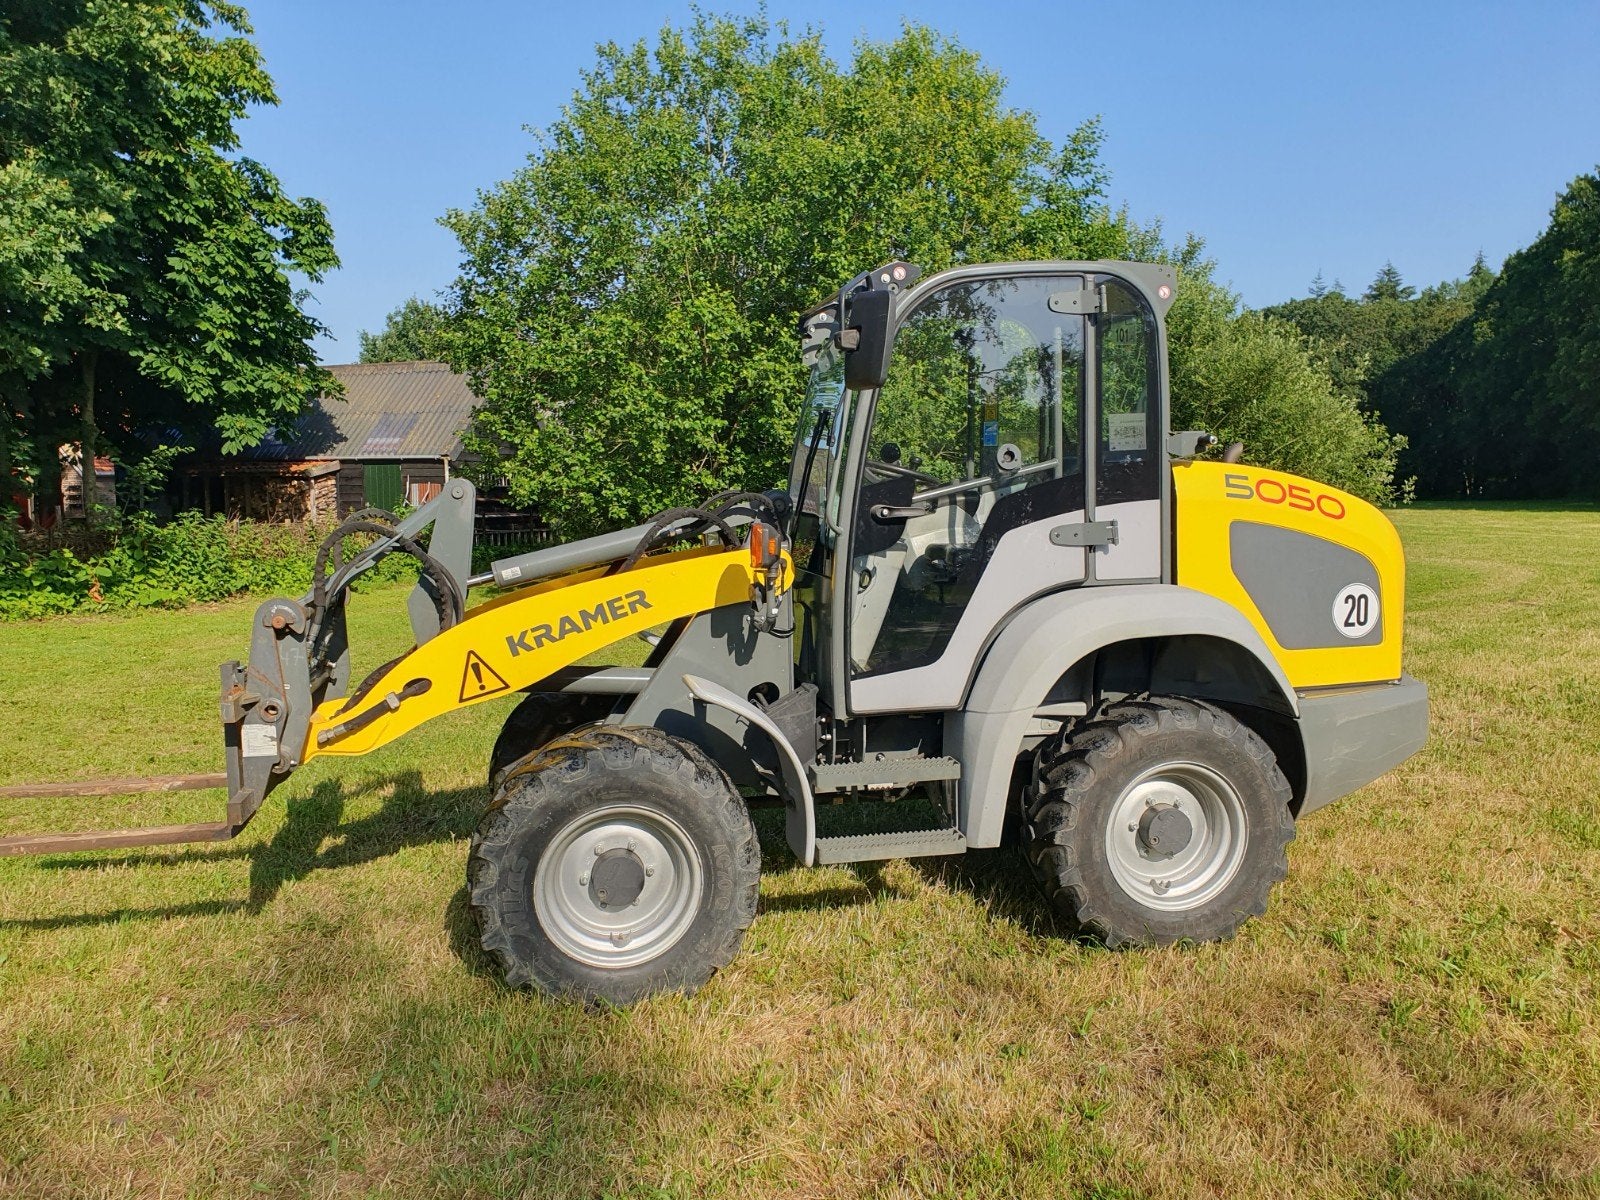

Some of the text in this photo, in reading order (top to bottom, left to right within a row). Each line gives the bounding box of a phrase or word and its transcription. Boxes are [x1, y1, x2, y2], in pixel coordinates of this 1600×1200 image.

[1224, 473, 1346, 521] 5050
[505, 589, 653, 657] KRAMER
[1343, 593, 1369, 628] 20
